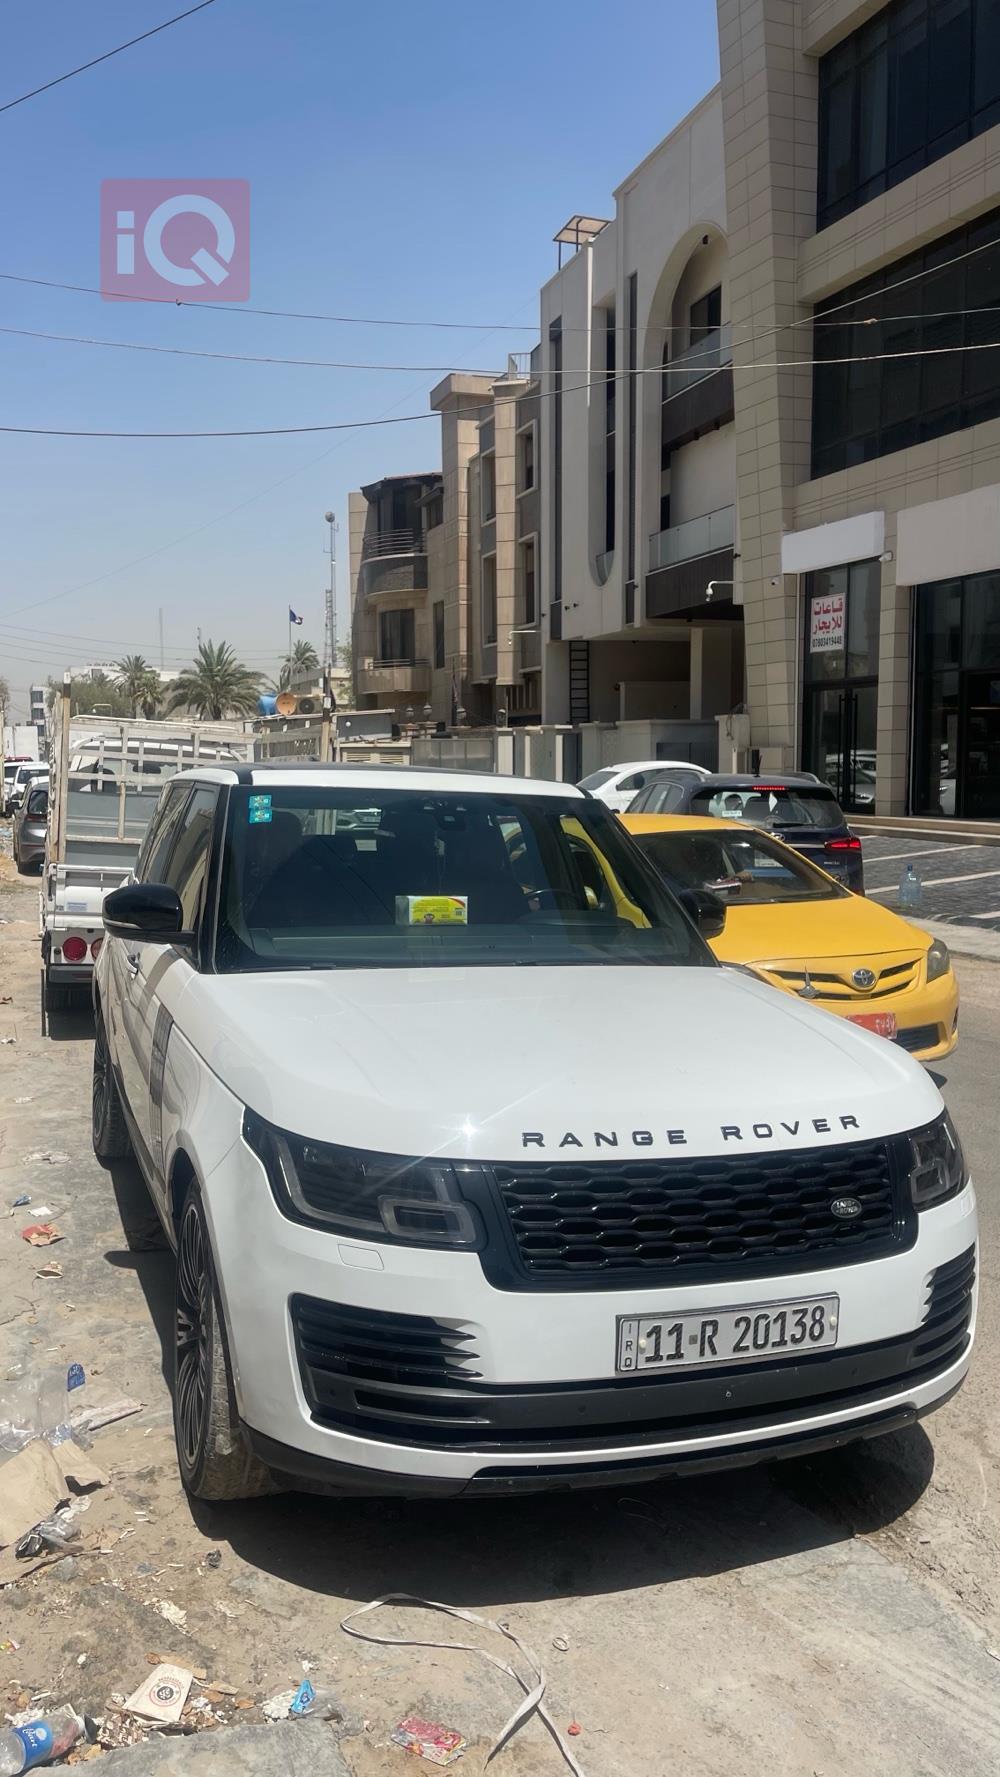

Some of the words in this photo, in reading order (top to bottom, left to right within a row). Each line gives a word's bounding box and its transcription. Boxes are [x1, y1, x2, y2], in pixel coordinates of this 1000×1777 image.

[814, 597, 843, 615] قاعات
[522, 1130, 687, 1148] RANGE
[720, 1114, 860, 1141] ROVER
[645, 1323, 684, 1363] 11
[699, 1319, 719, 1357] R
[732, 1305, 825, 1353] 20138
